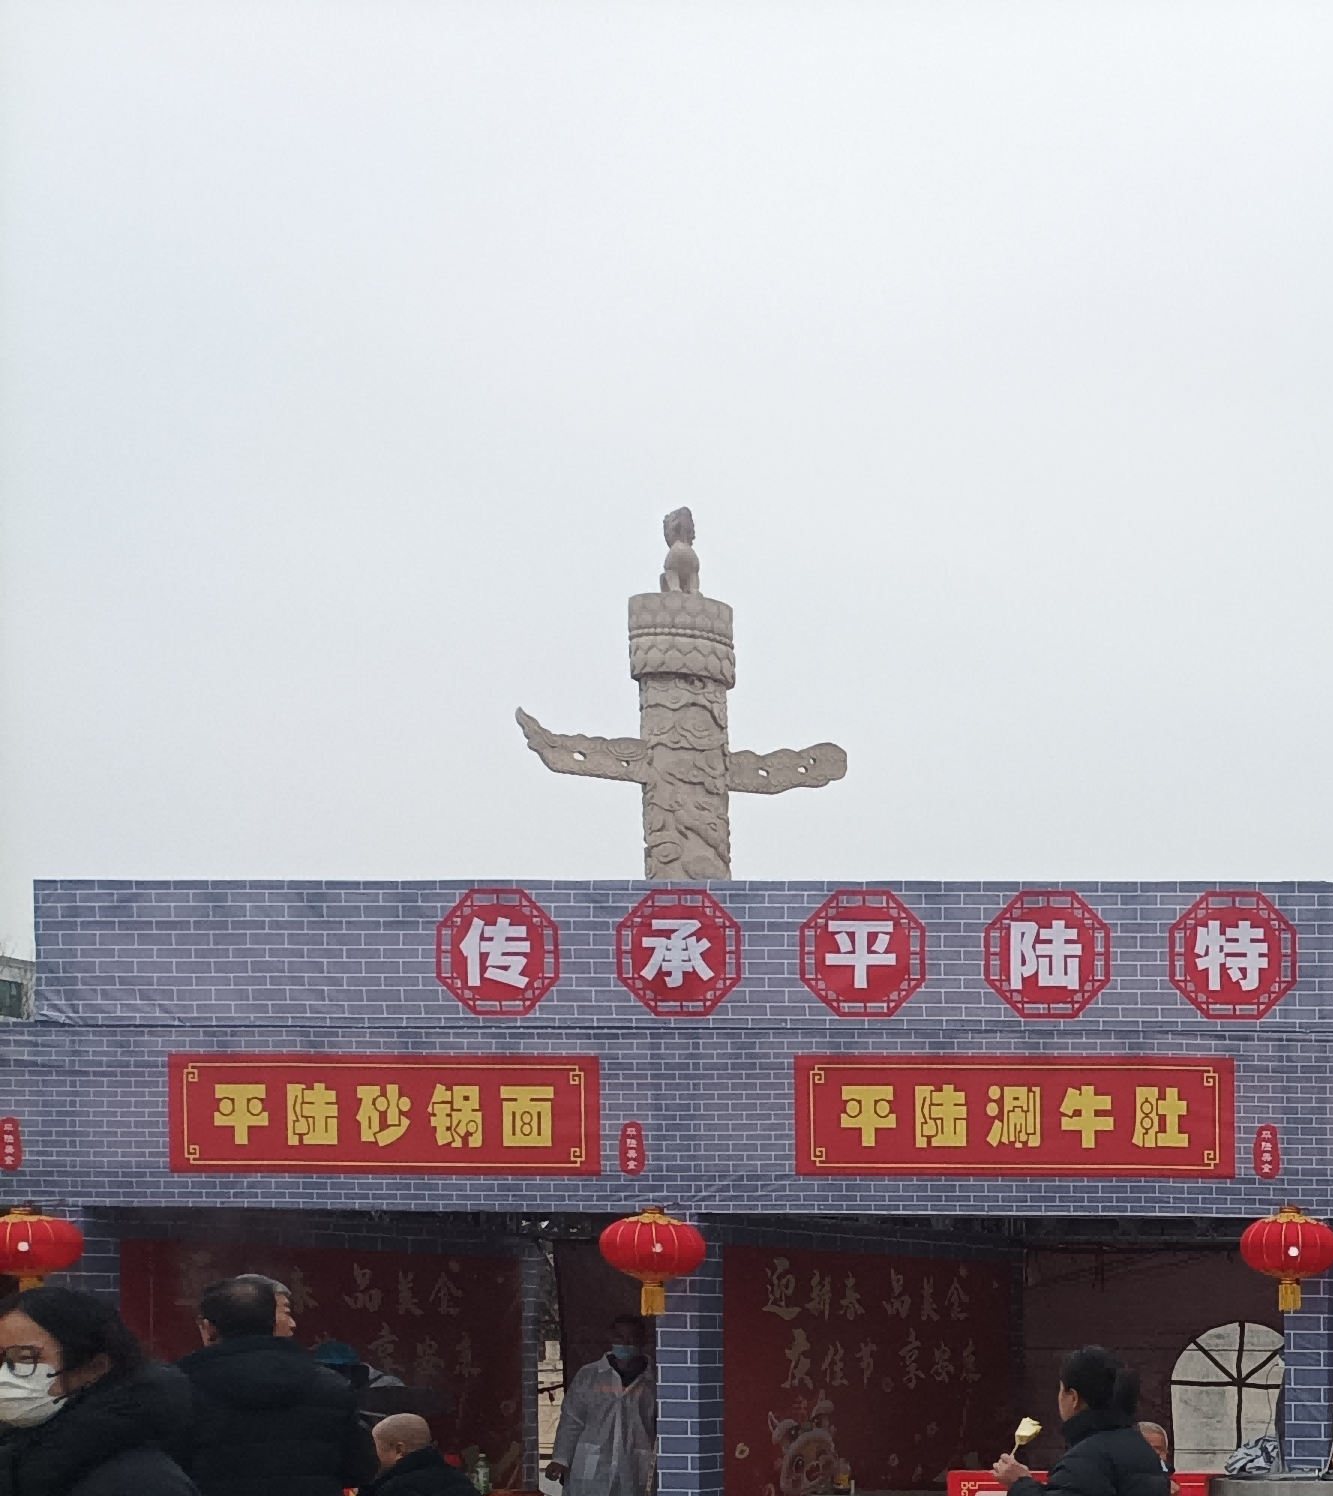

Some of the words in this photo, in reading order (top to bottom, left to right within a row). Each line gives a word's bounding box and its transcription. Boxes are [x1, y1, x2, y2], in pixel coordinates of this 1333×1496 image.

[213, 1082, 556, 1148] 平陆砂锅面
[839, 1084, 1190, 1149] 平陆涮牛肚
[761, 1256, 866, 1322] 迎新春
[882, 1266, 971, 1322] 品美食
